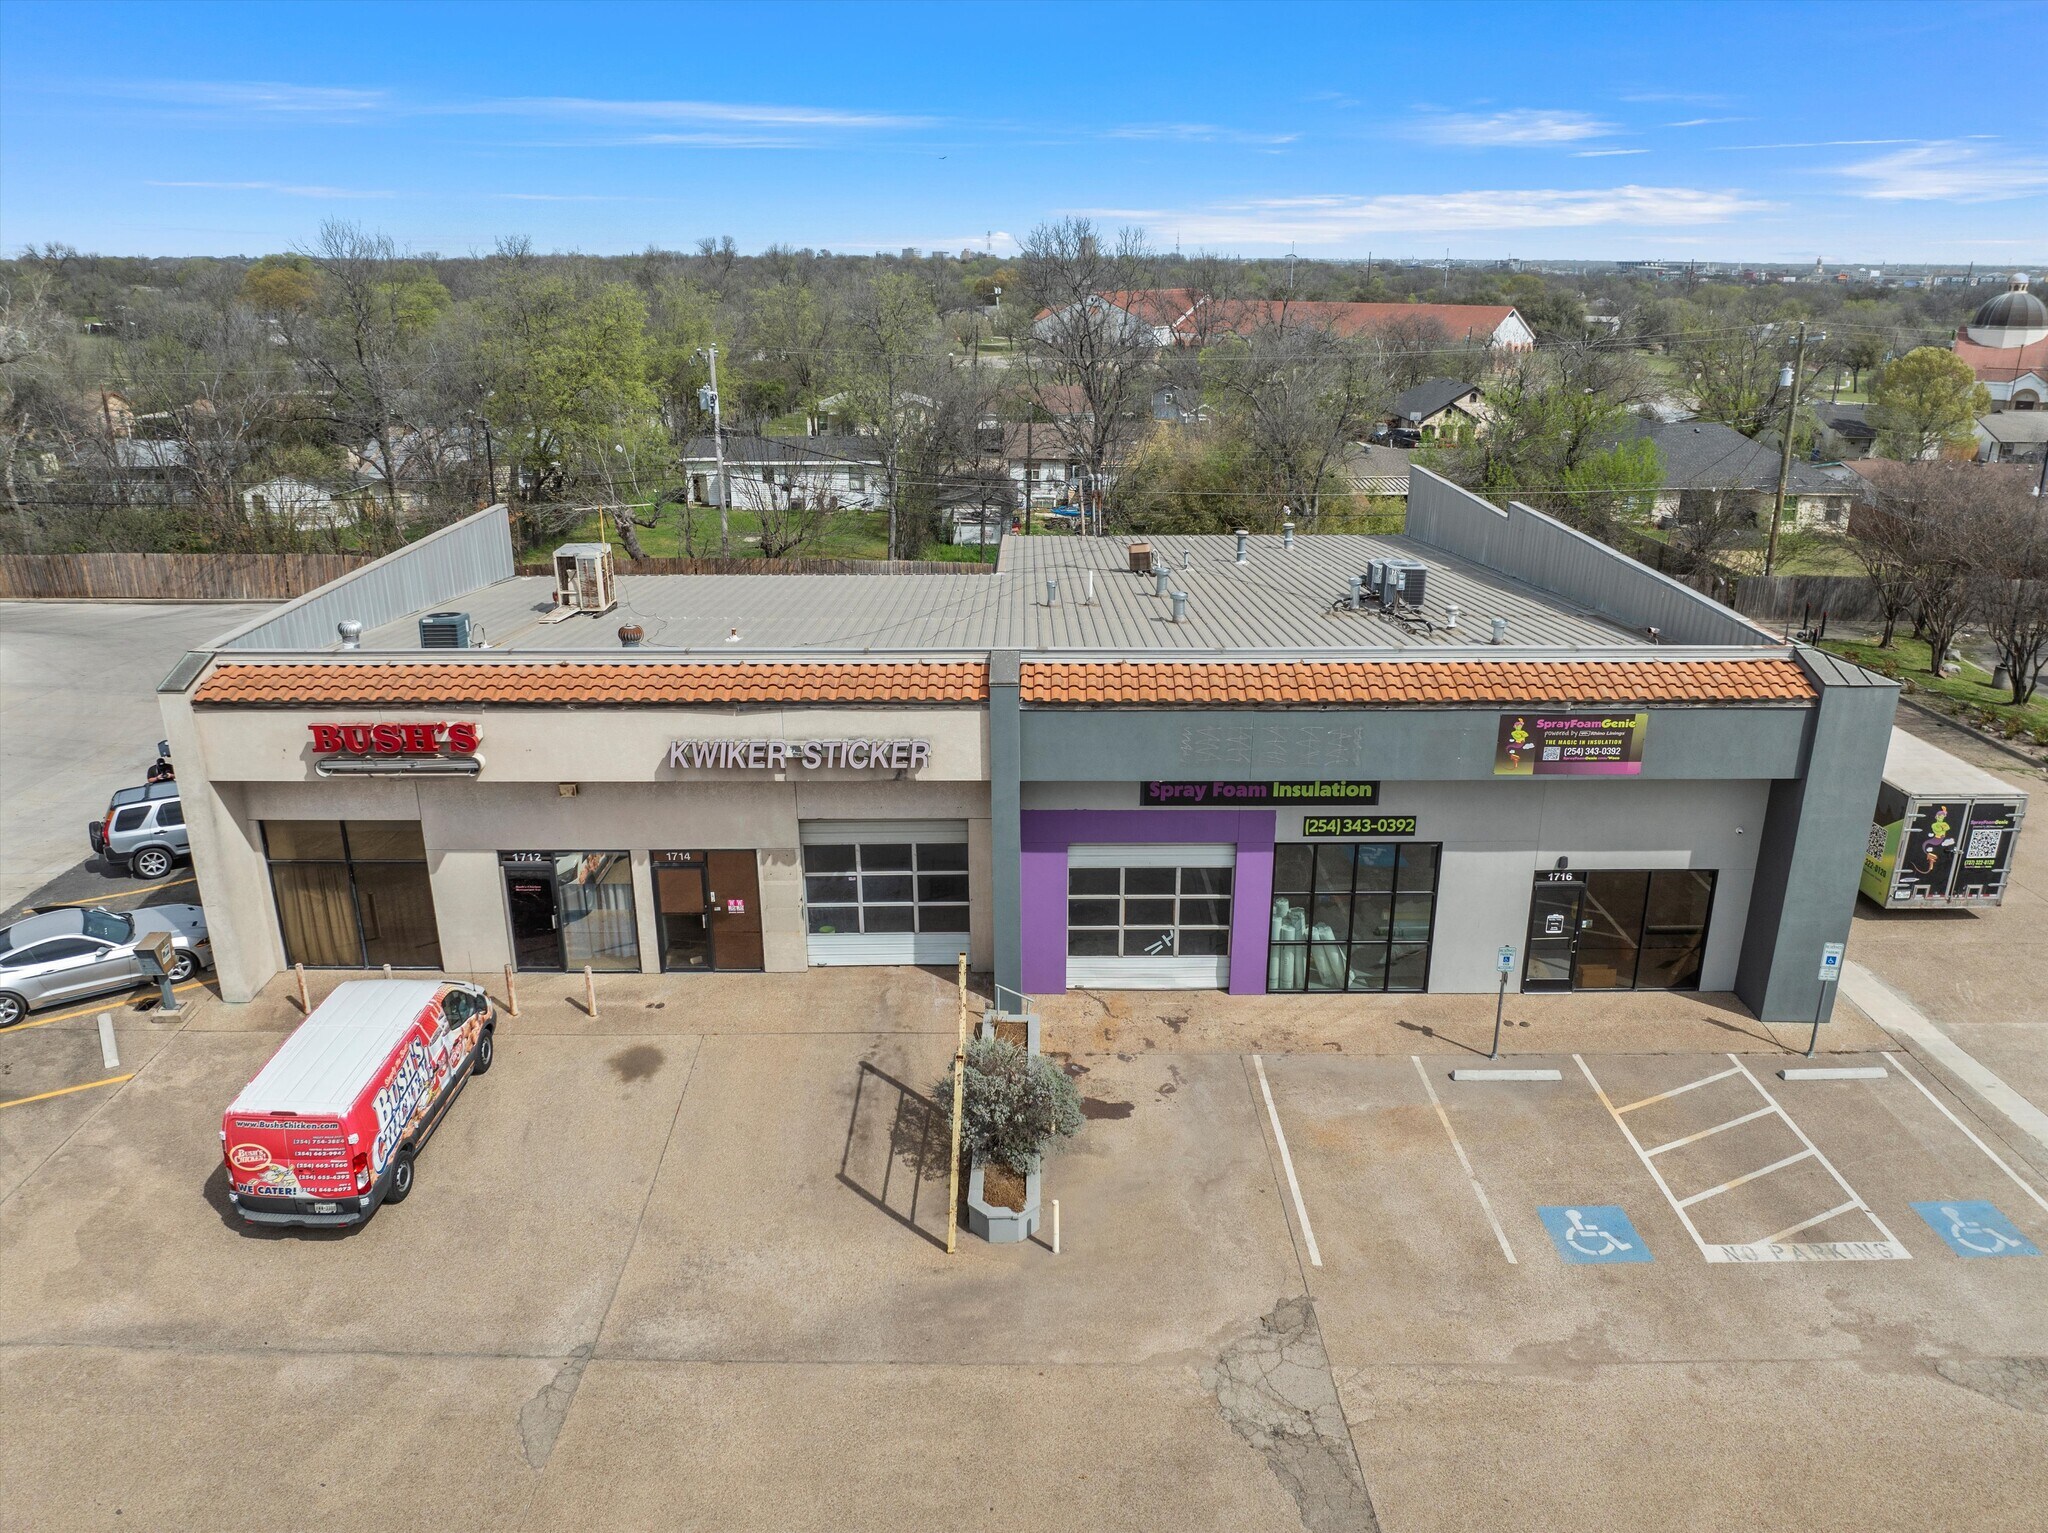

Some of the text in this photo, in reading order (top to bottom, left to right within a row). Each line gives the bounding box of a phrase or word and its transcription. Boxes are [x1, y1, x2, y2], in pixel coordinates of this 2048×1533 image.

[1536, 719, 1636, 730] SprayFoamGenie
[308, 721, 479, 754] BUSH'S
[669, 739, 932, 770] KWIKER STICKER
[1564, 747, 1621, 756] (254) 343-0392
[1149, 781, 1372, 801] Spray Foam Insulation
[1305, 818, 1416, 835] (254) 343-0392
[512, 852, 542, 862] 1712
[666, 852, 691, 861] 1714
[1548, 872, 1573, 881] 1716
[372, 1035, 424, 1132] BUSH'S
[236, 1120, 338, 1130] www.BushsChicken.com
[237, 1184, 297, 1195] WE CATER!
[1720, 1243, 1894, 1262] NO PARKING
